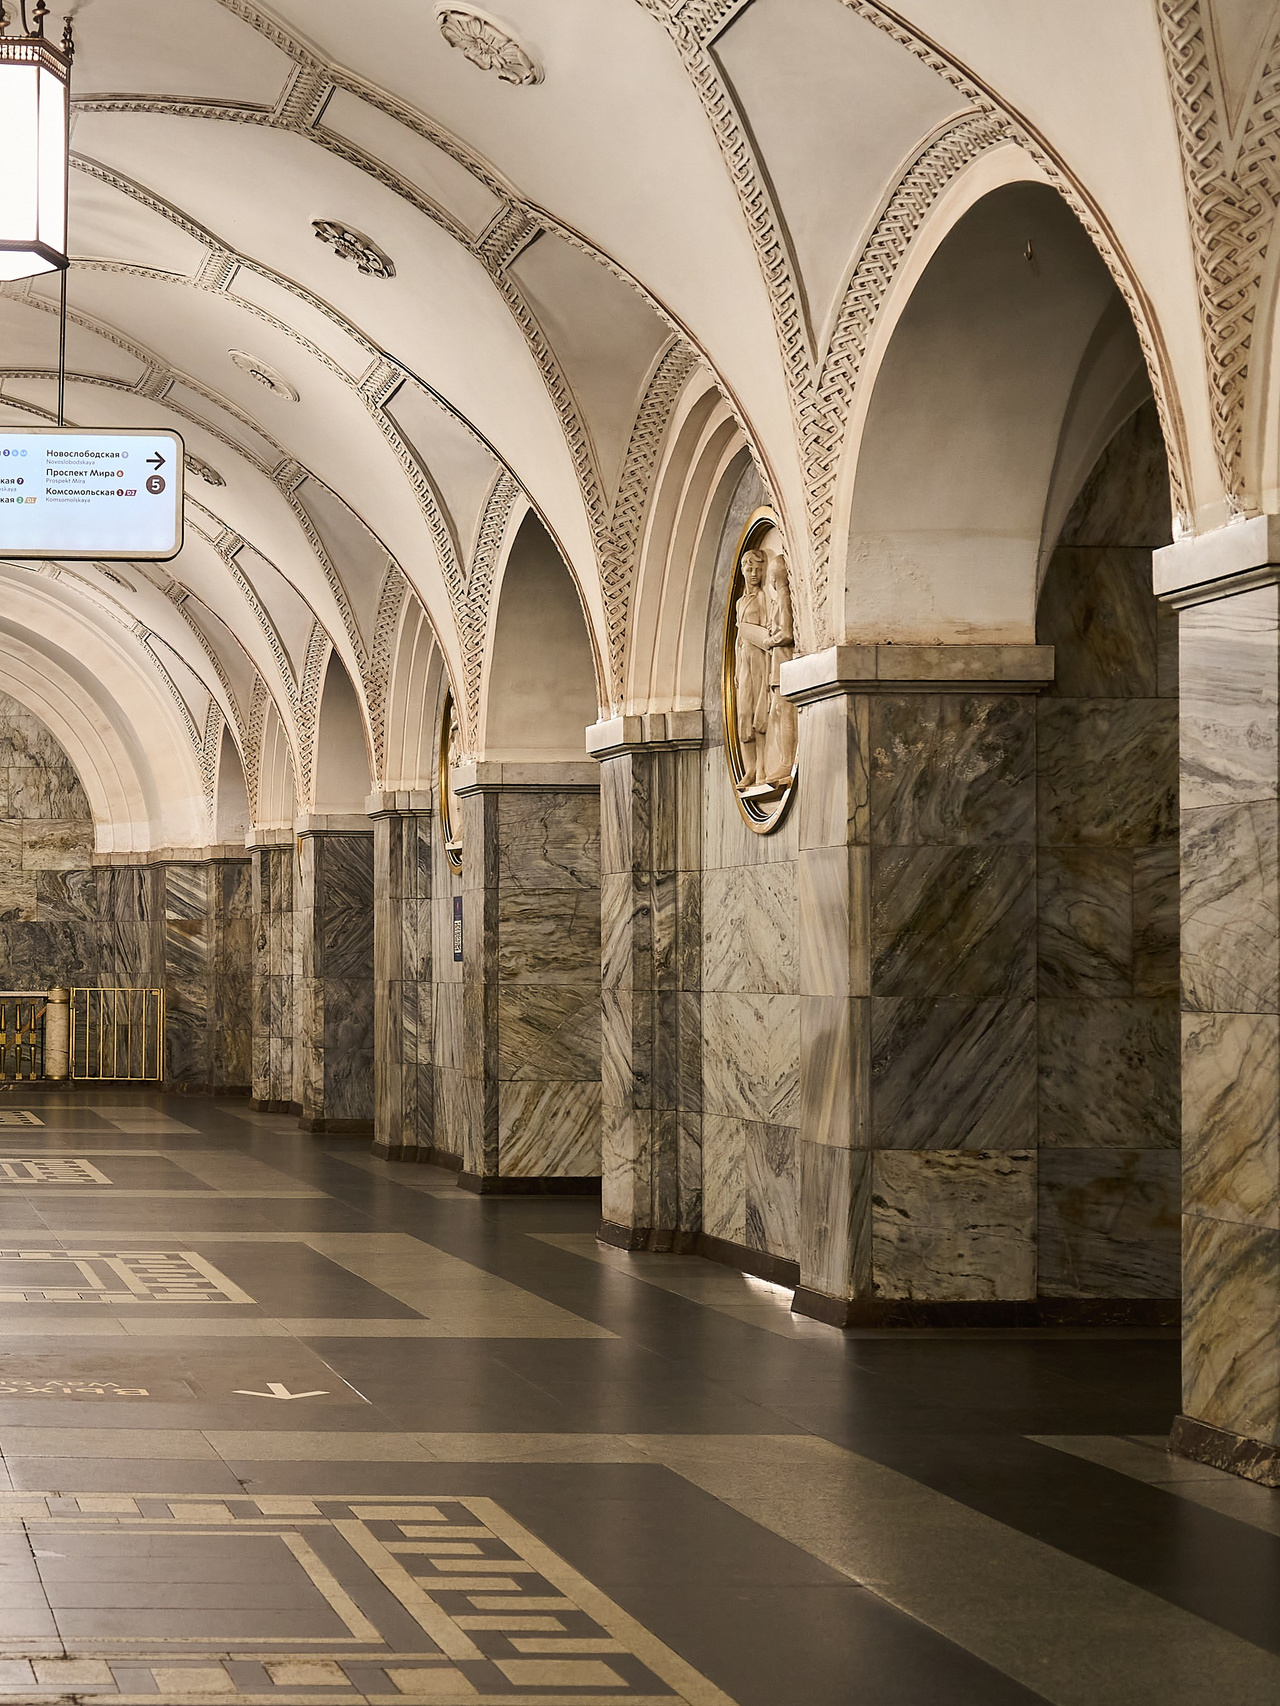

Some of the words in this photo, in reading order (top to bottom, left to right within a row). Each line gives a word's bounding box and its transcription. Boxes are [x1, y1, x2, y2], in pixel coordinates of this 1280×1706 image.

[46, 450, 120, 458] Новослободская
[46, 469, 88, 478] Проспект
[90, 470, 115, 478] Мира
[151, 479, 160, 490] 5
[46, 488, 114, 496] Комсомольская
